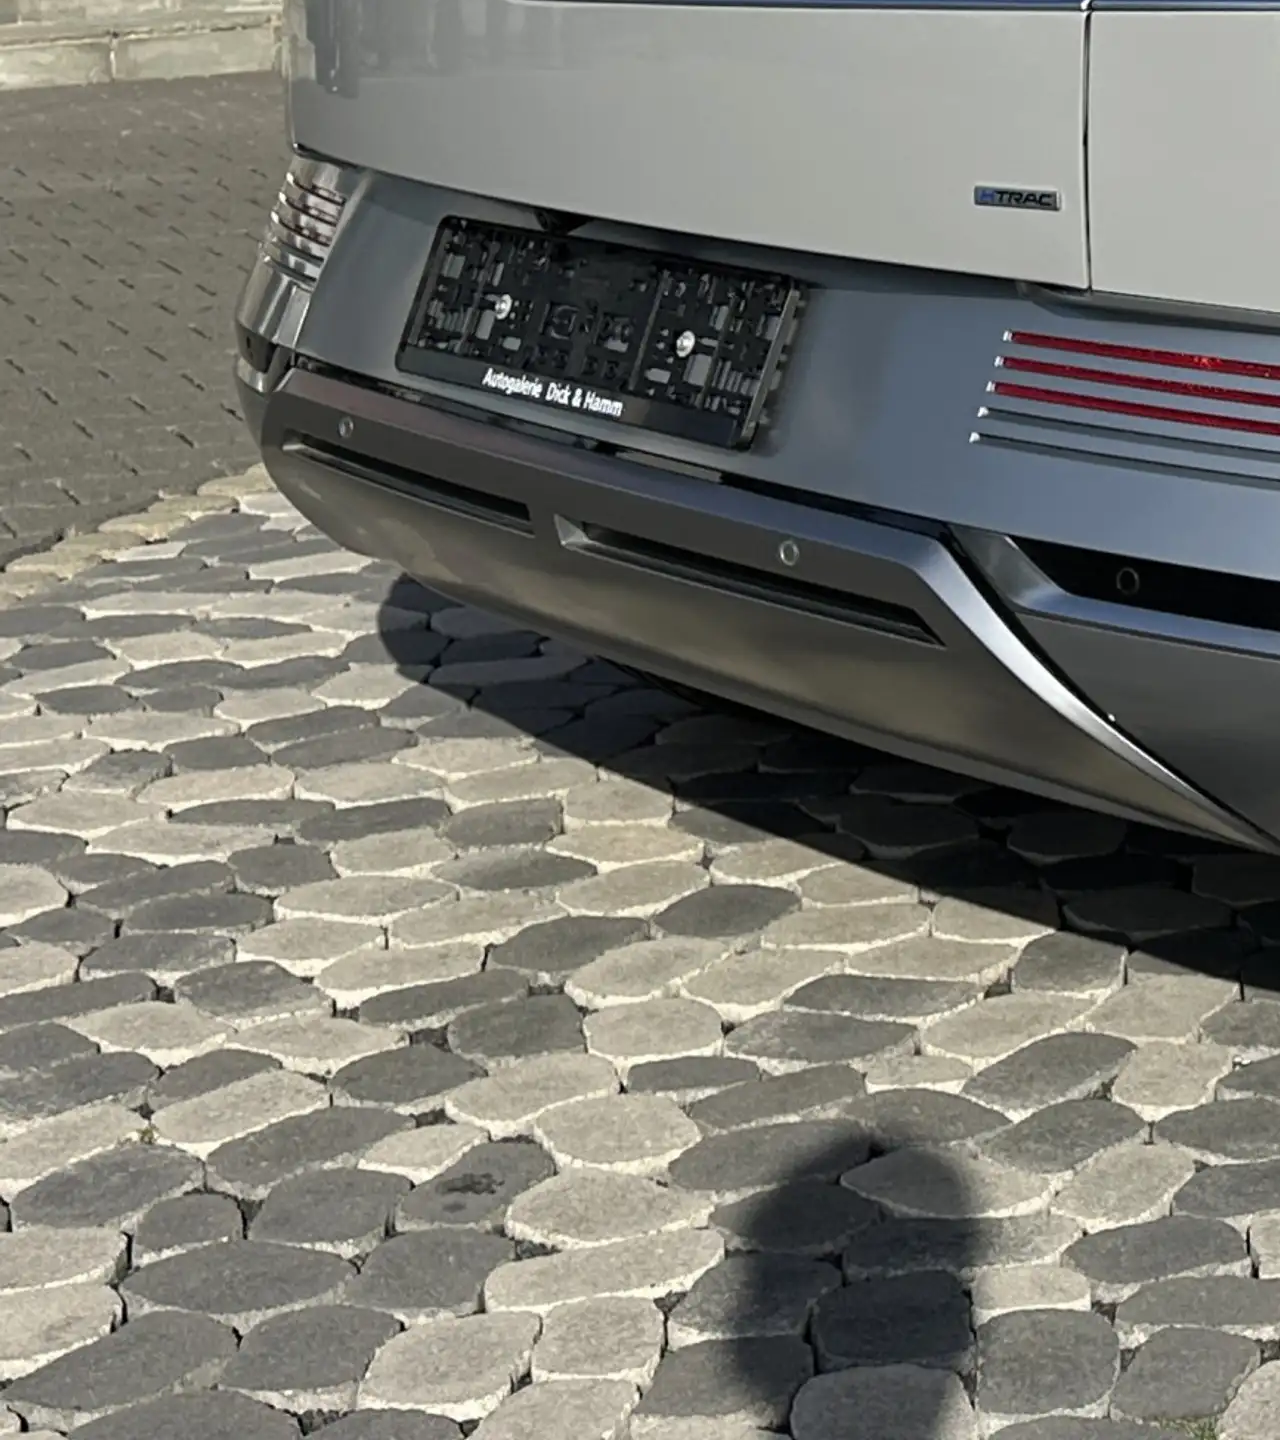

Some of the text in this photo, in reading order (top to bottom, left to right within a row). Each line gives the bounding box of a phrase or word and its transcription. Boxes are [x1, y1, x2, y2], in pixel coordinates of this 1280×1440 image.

[481, 367, 624, 417] Autogalerie Dick & Hamm
